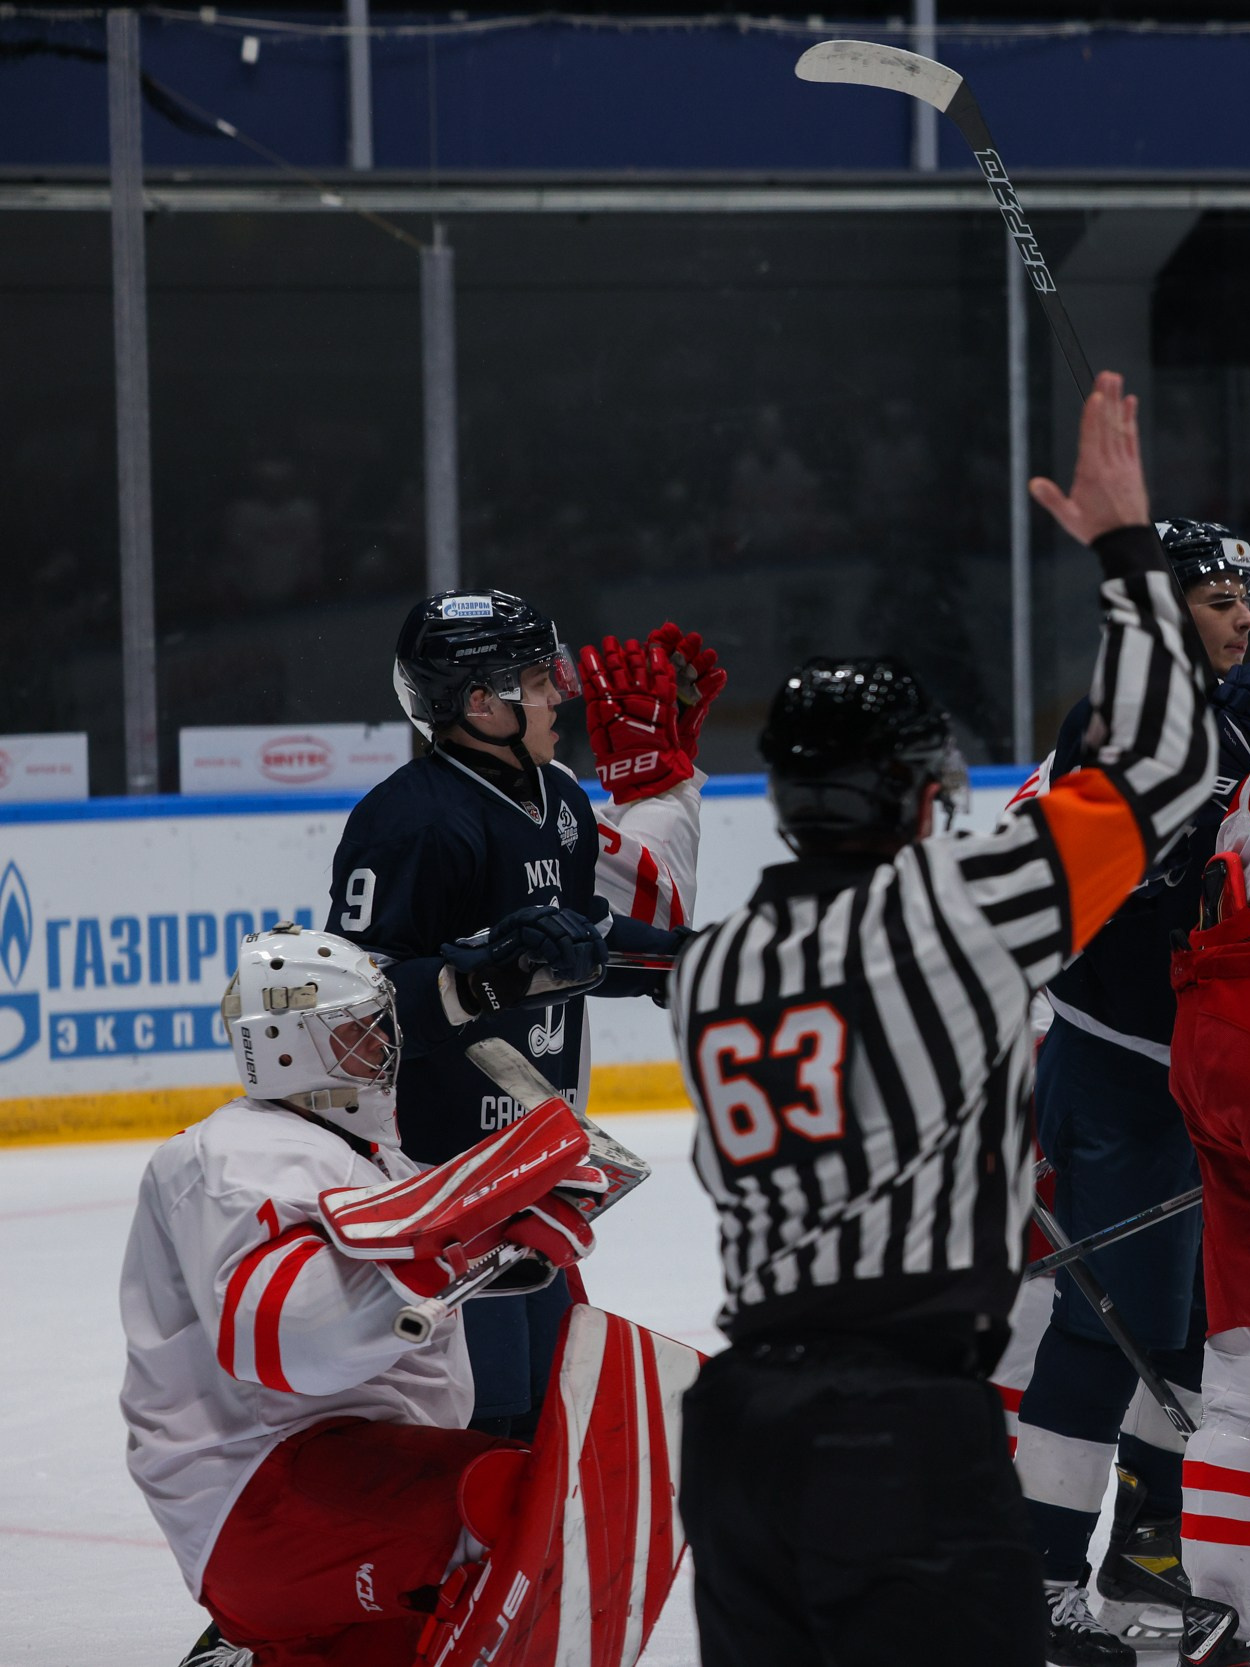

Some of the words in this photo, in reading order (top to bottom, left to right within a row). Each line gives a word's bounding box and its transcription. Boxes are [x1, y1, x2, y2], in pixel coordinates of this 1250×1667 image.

[458, 602, 490, 610] ГАЗПРОМ
[455, 643, 498, 658] BAUER
[344, 867, 377, 932] 9
[46, 908, 313, 989] ГАЗПРО
[481, 982, 500, 1011] CCM
[241, 1026, 258, 1085] BAUER
[698, 1001, 847, 1166] 63
[463, 1136, 581, 1208] TRUE
[355, 1563, 383, 1612] CCM
